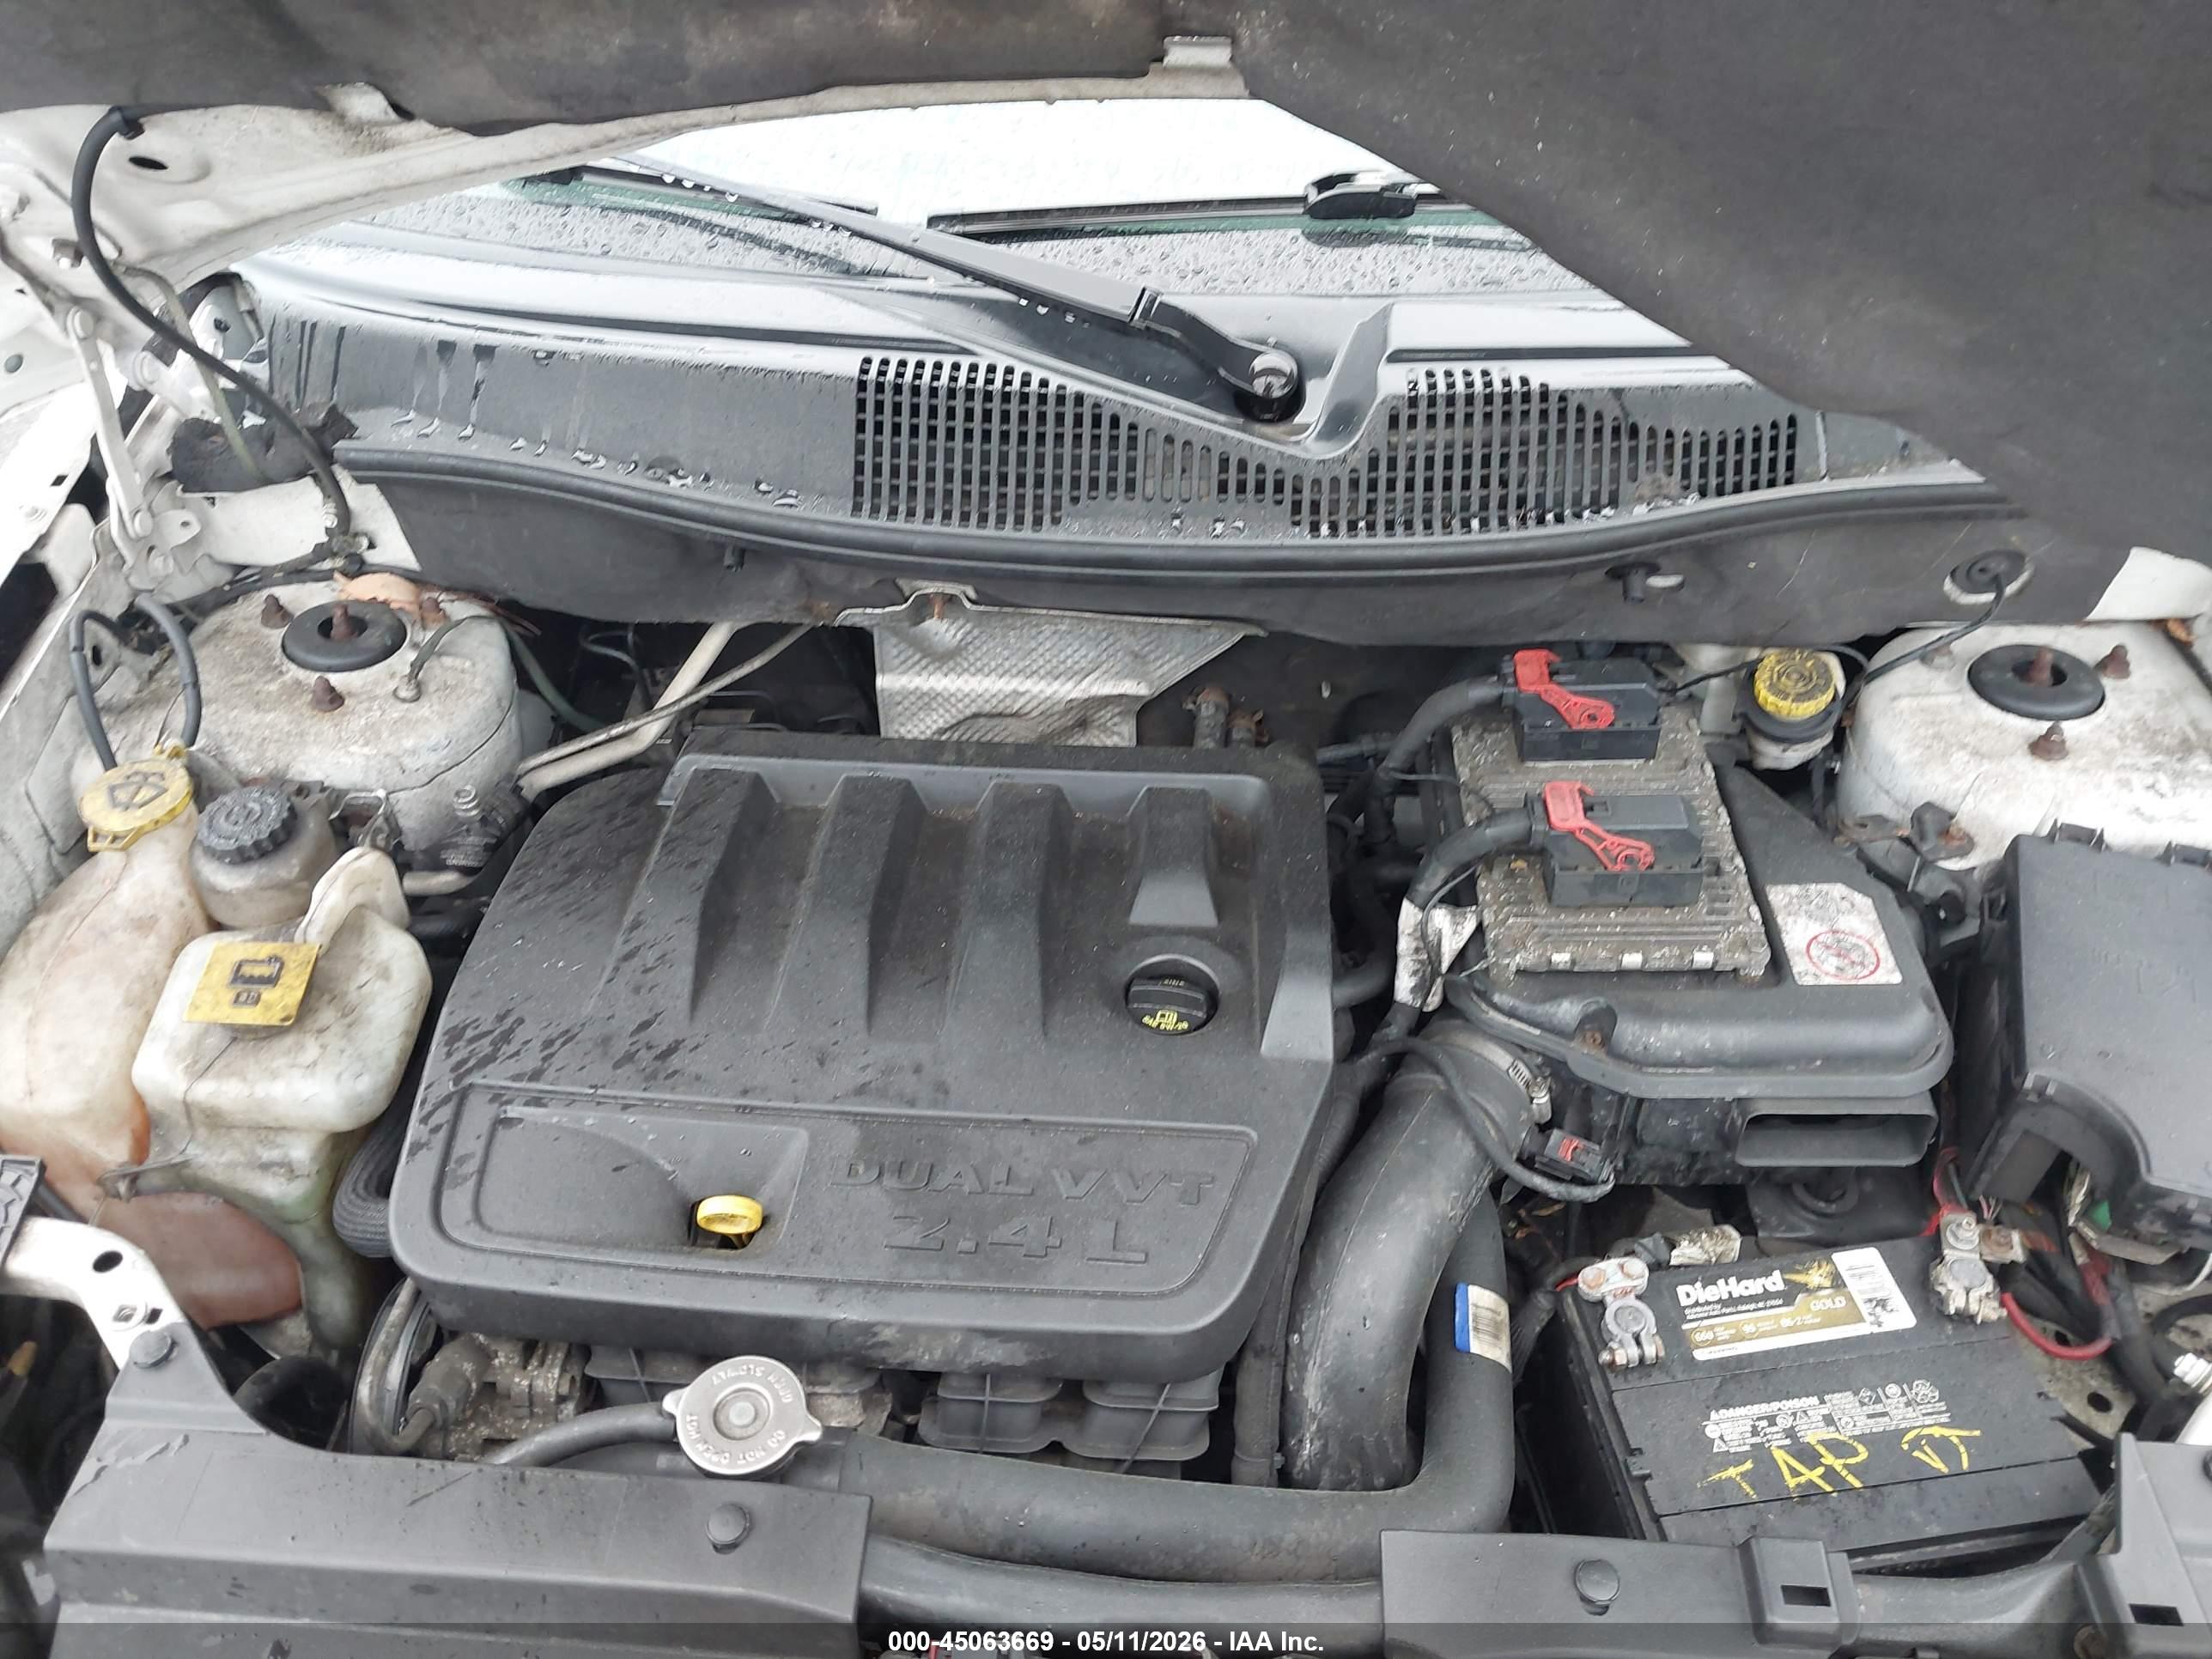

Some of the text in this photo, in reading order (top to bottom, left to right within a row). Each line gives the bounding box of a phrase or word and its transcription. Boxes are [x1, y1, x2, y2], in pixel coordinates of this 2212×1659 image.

[830, 1159, 1215, 1206] DUAL VVT
[1676, 1269, 1785, 1306] DieHard
[1809, 1295, 1847, 1311] GOLD
[686, 1414, 787, 1464] DO NOT OPEN HOT
